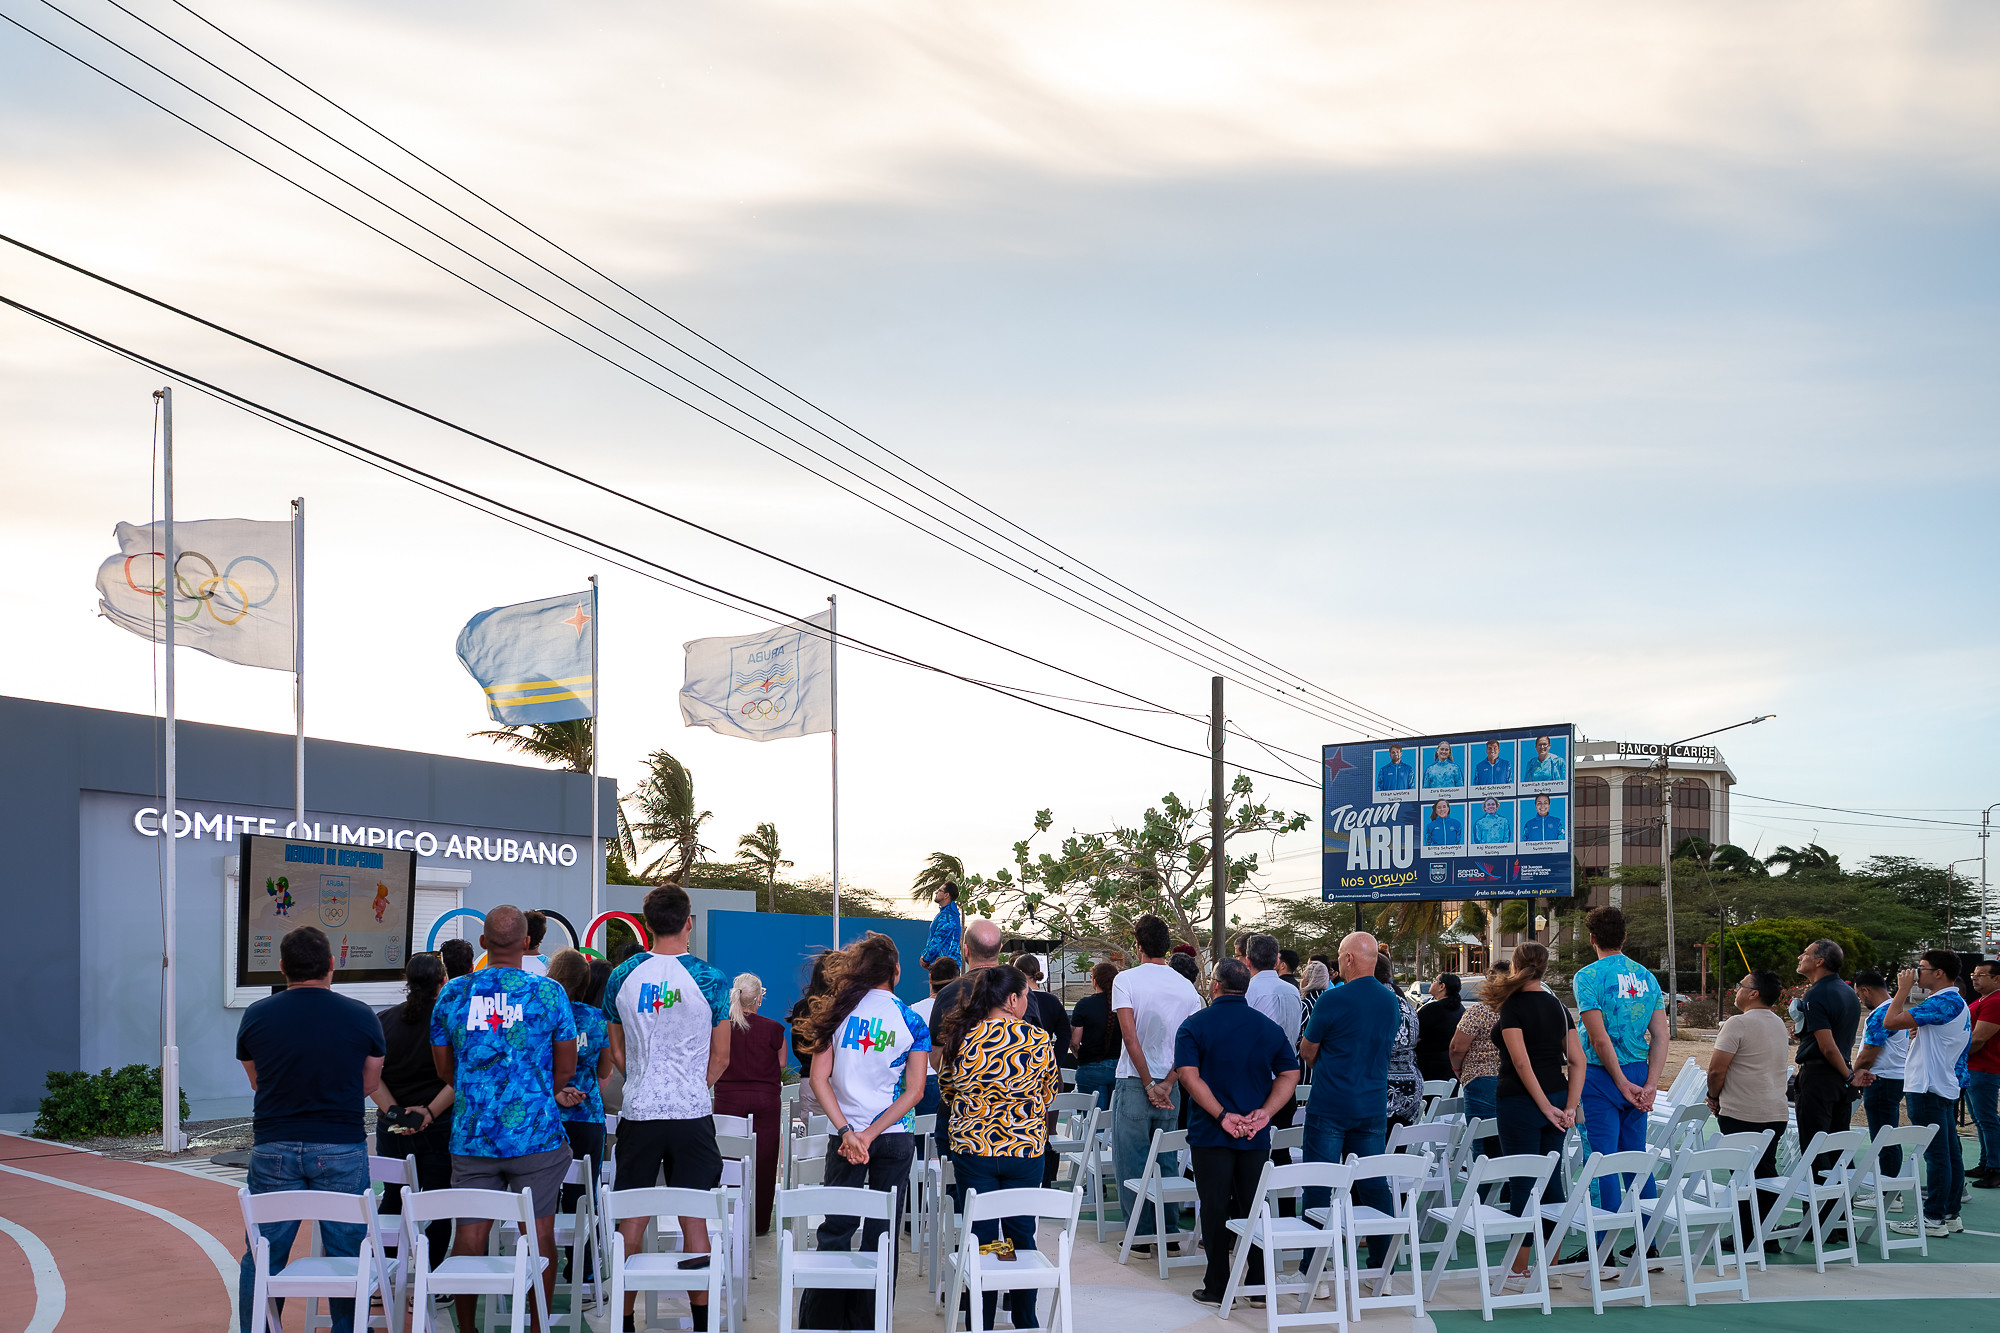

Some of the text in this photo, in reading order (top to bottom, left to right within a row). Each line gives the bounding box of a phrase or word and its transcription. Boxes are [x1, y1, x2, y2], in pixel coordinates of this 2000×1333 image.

[1619, 743, 1658, 755] BANCO
[1675, 746, 1715, 758] CARIBE
[1330, 802, 1400, 834] Team
[134, 807, 277, 841] COMITE
[444, 834, 578, 867] ARUBANO
[1346, 824, 1414, 871] ARU
[284, 843, 384, 869] REUNION DI DESPEDIDA
[637, 980, 682, 1014] ARUBA
[1617, 972, 1649, 999] ARUBA
[466, 992, 524, 1031] ARUBA
[841, 1015, 896, 1052] ARUBA
